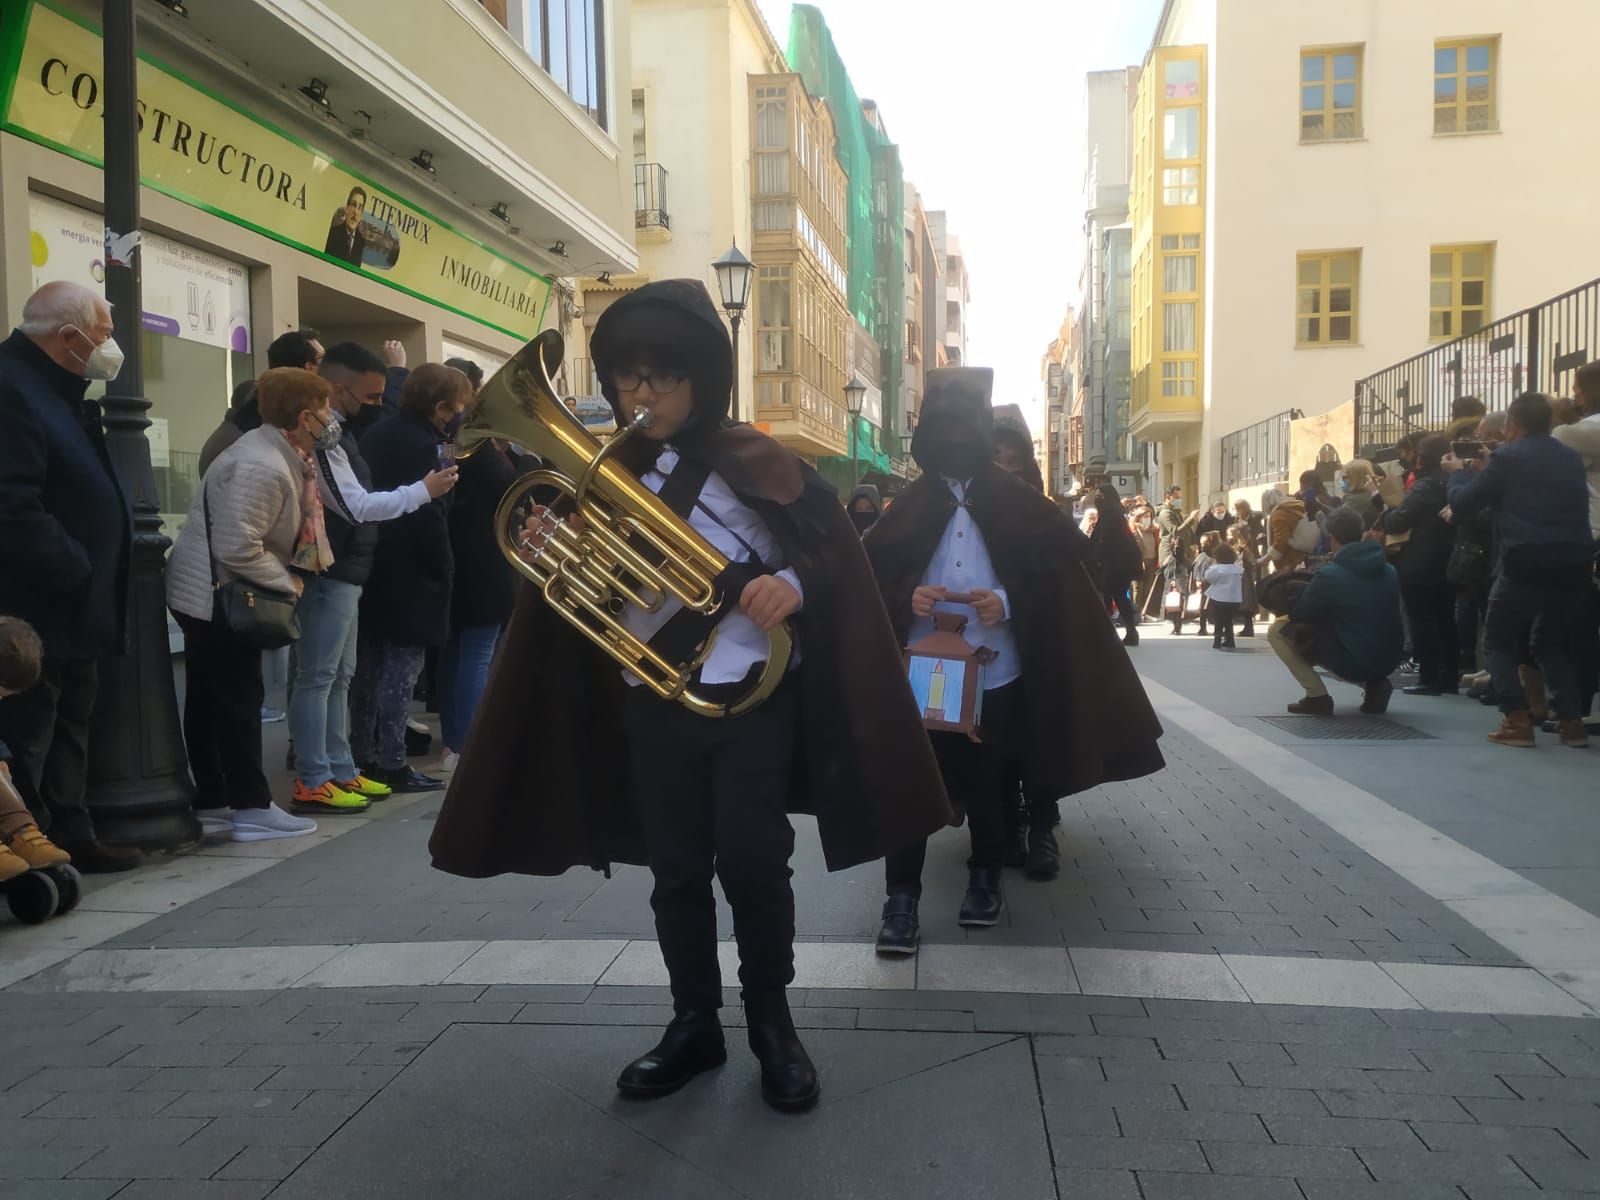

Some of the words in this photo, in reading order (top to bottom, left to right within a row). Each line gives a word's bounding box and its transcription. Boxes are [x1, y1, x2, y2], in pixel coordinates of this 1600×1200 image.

[40, 58, 307, 211] COSTRUCTORA
[370, 195, 432, 245] TTEMPUX
[440, 255, 537, 319] INMOBILIARIA
